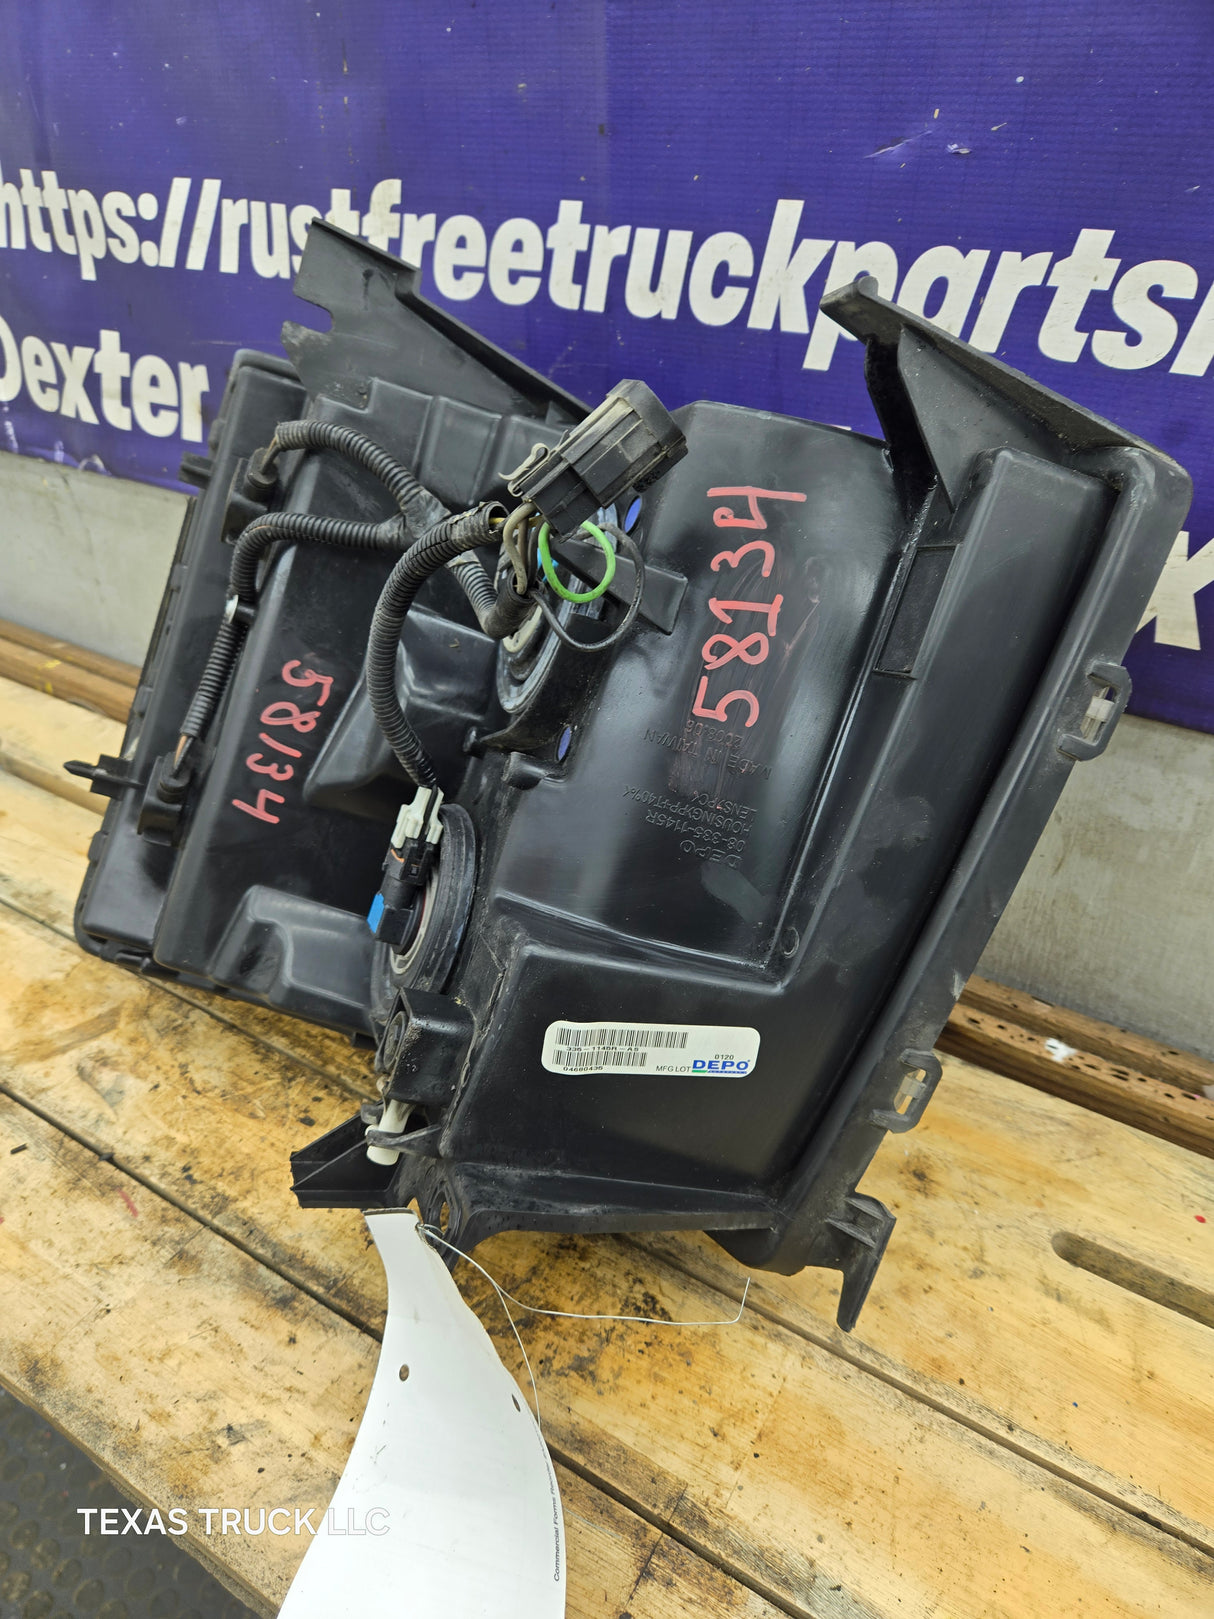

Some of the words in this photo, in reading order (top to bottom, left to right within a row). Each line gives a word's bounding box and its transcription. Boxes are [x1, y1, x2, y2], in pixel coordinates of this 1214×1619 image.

[691, 485, 807, 728] 58134
[231, 659, 335, 824] 58134
[680, 839, 743, 868] DEPO
[675, 1065, 691, 1073] LOT
[692, 1059, 750, 1070] DEPO
